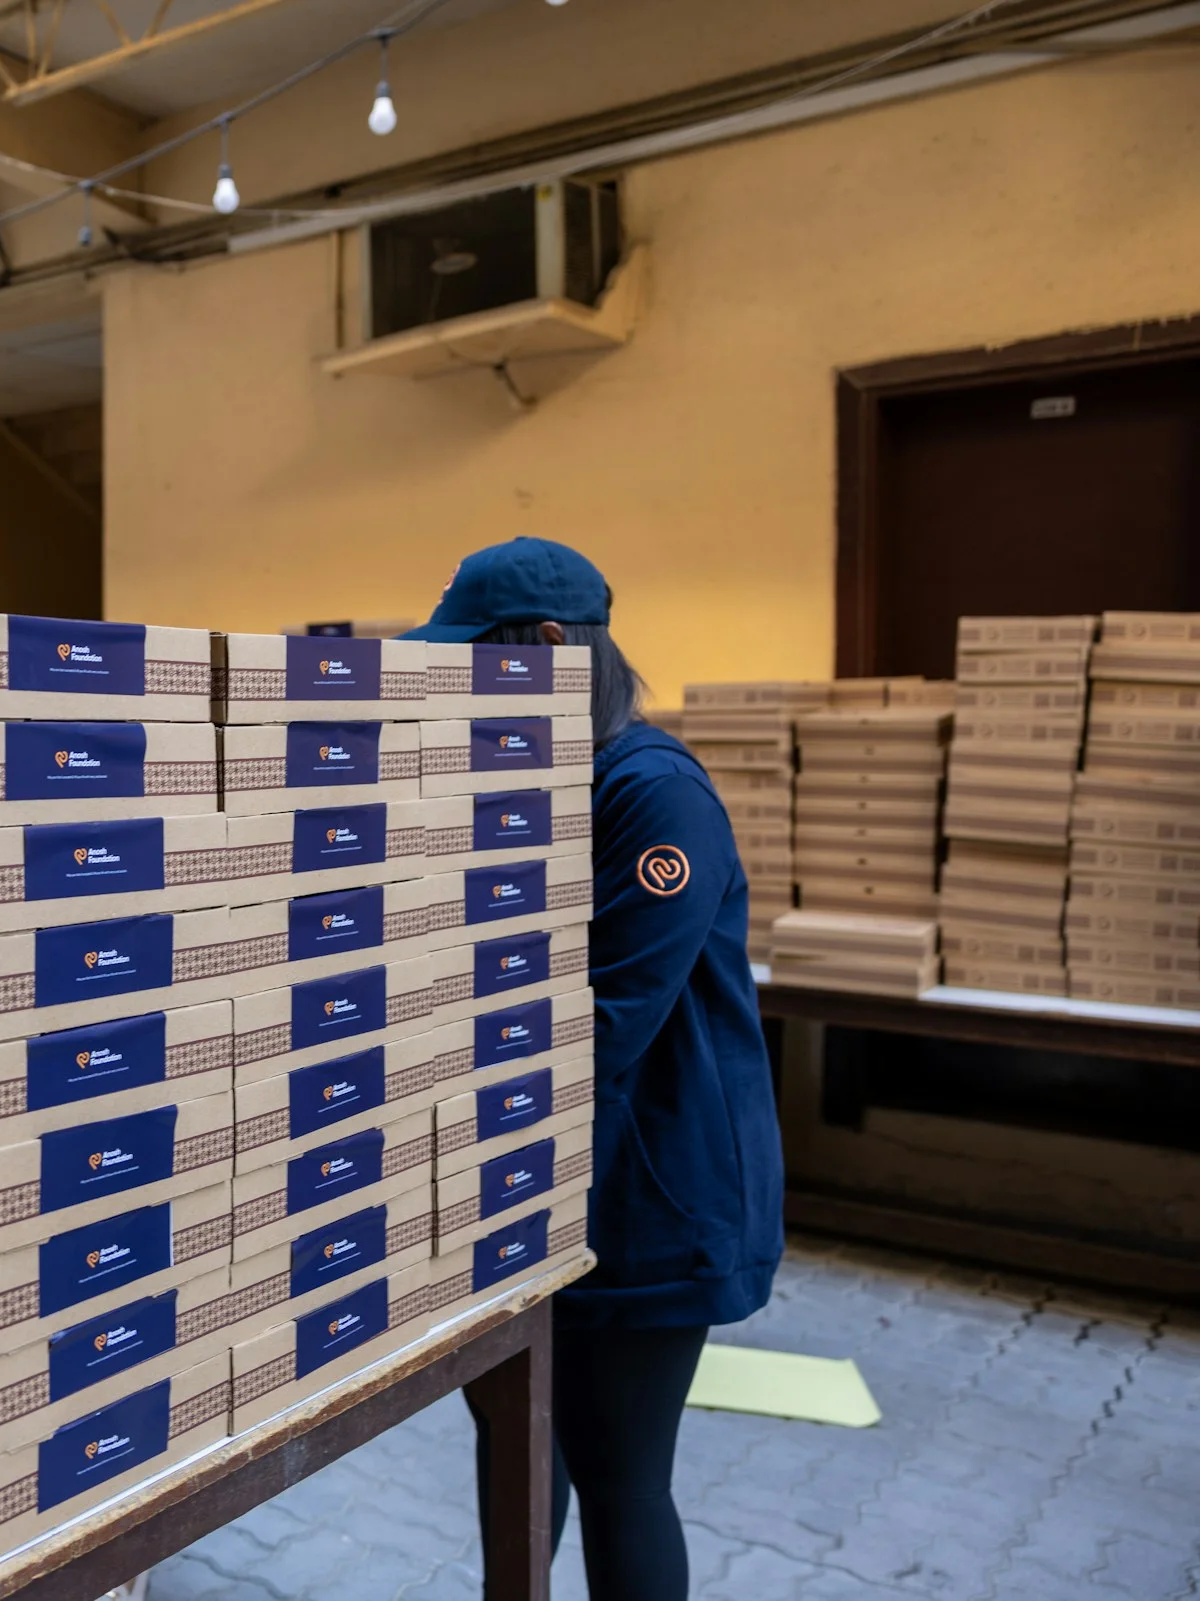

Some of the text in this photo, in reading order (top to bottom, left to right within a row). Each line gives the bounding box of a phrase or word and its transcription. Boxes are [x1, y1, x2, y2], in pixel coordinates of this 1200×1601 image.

[71, 645, 90, 653] Anosh
[71, 653, 102, 662] Foundation
[69, 751, 88, 759] Anosh
[68, 759, 101, 767] Foundation
[88, 855, 120, 863] Foundation
[98, 949, 117, 958] Anosh
[98, 956, 130, 966] Foundation
[90, 1048, 110, 1058] Anosh
[90, 1054, 122, 1066] Foundation
[102, 1148, 121, 1159] Anosh
[102, 1154, 133, 1166] Foundation
[99, 1248, 130, 1264] Foundation
[107, 1330, 137, 1346] Foundation
[98, 1437, 130, 1454] Foundation
